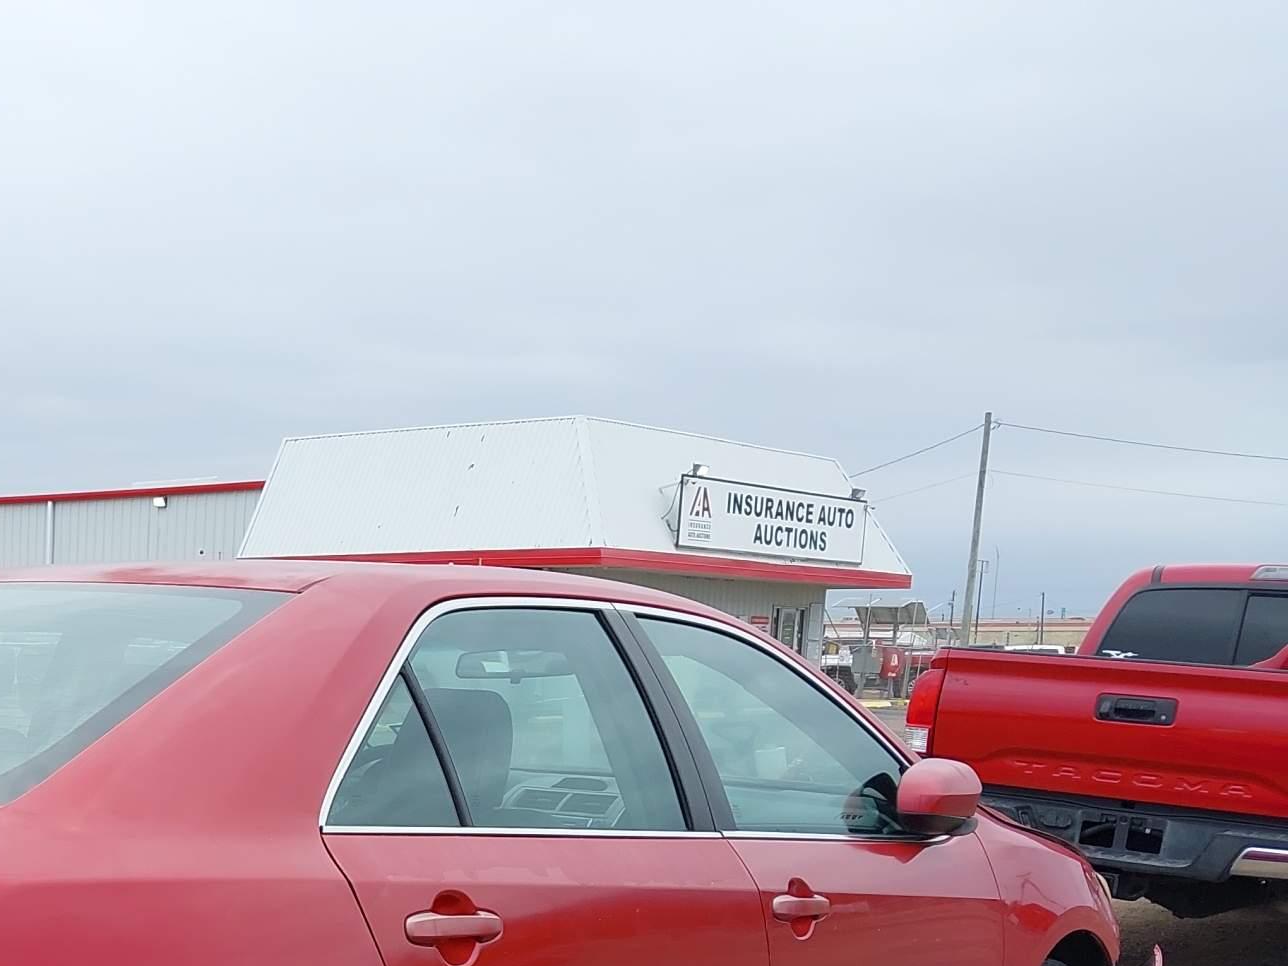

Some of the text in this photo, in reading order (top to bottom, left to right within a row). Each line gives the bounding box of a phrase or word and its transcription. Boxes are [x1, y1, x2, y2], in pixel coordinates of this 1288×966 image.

[727, 492, 855, 529] INSURANCE AUTO
[753, 523, 827, 552] AUCTIONS
[1014, 759, 1254, 798] TACOMA
